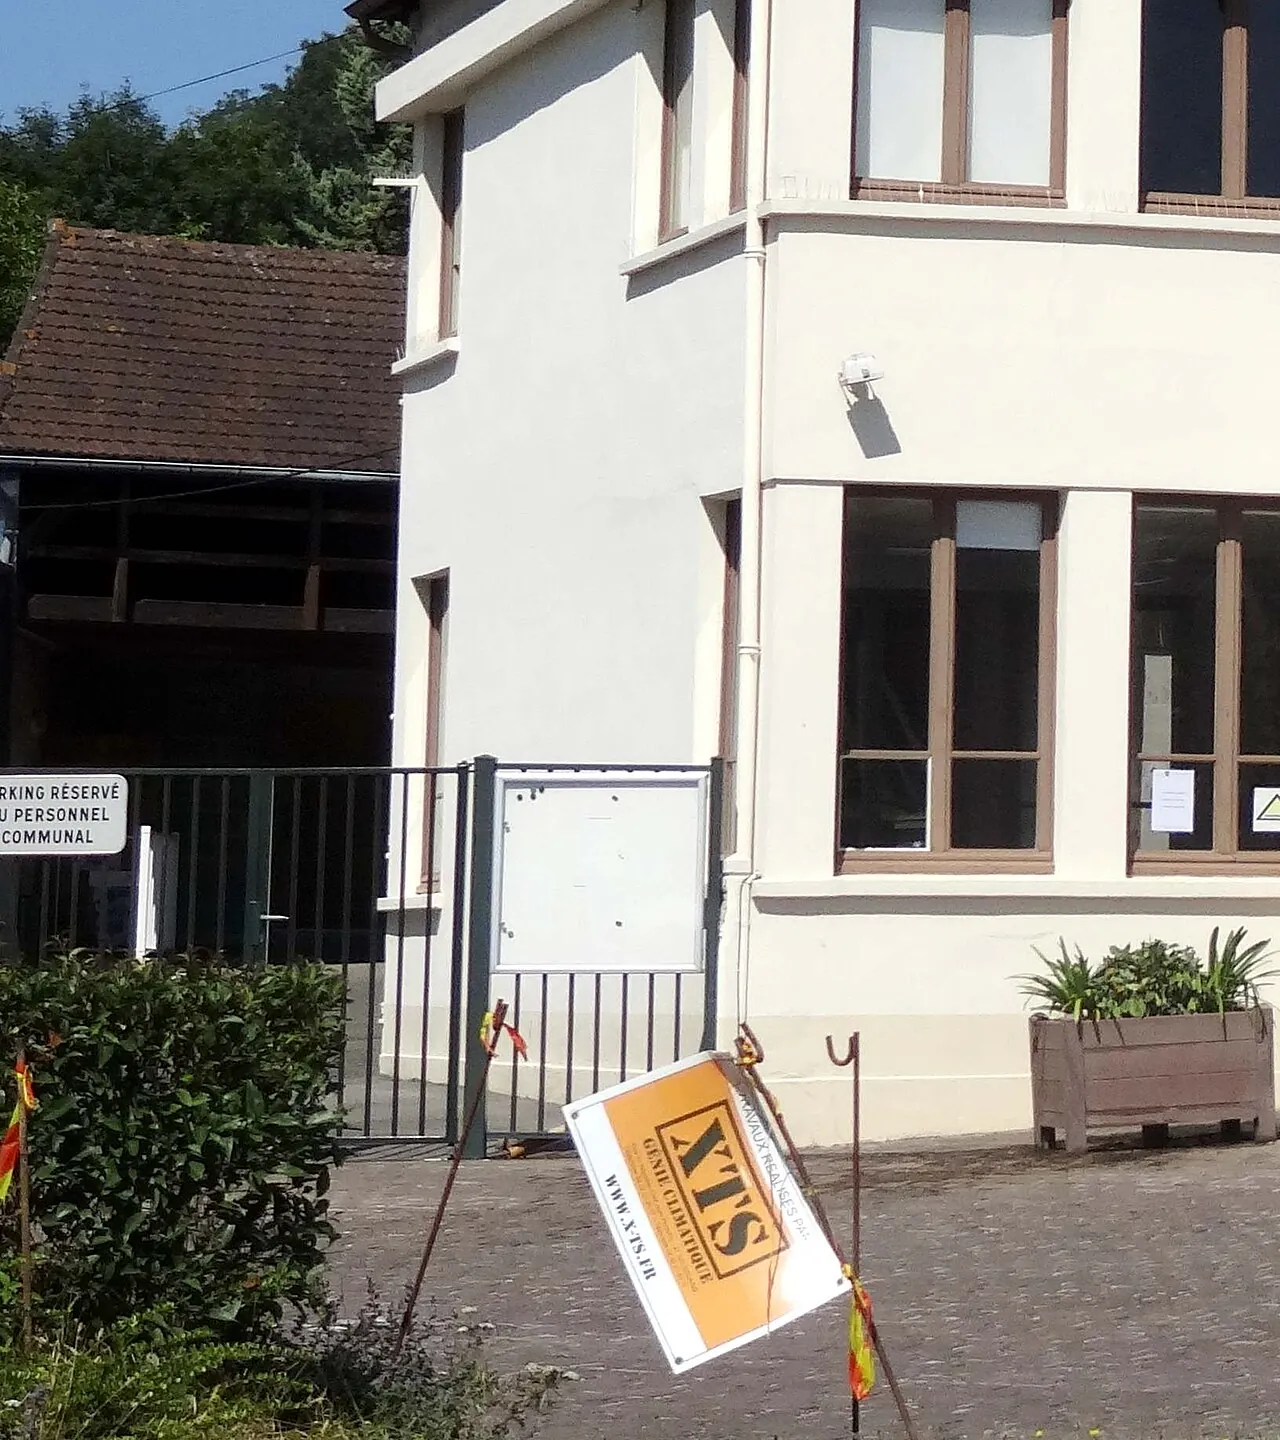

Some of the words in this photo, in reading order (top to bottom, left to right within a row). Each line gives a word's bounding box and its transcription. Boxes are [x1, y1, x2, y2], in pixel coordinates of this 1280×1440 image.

[14, 808, 110, 822] PERSONNEL
[51, 782, 119, 799] RÉSERVÉ
[2, 830, 93, 844] COMMUNAL
[670, 1117, 770, 1256] XTS
[605, 1174, 656, 1280] WWW.X-TS.FR
[663, 1189, 713, 1284] CLIMATIQUE
